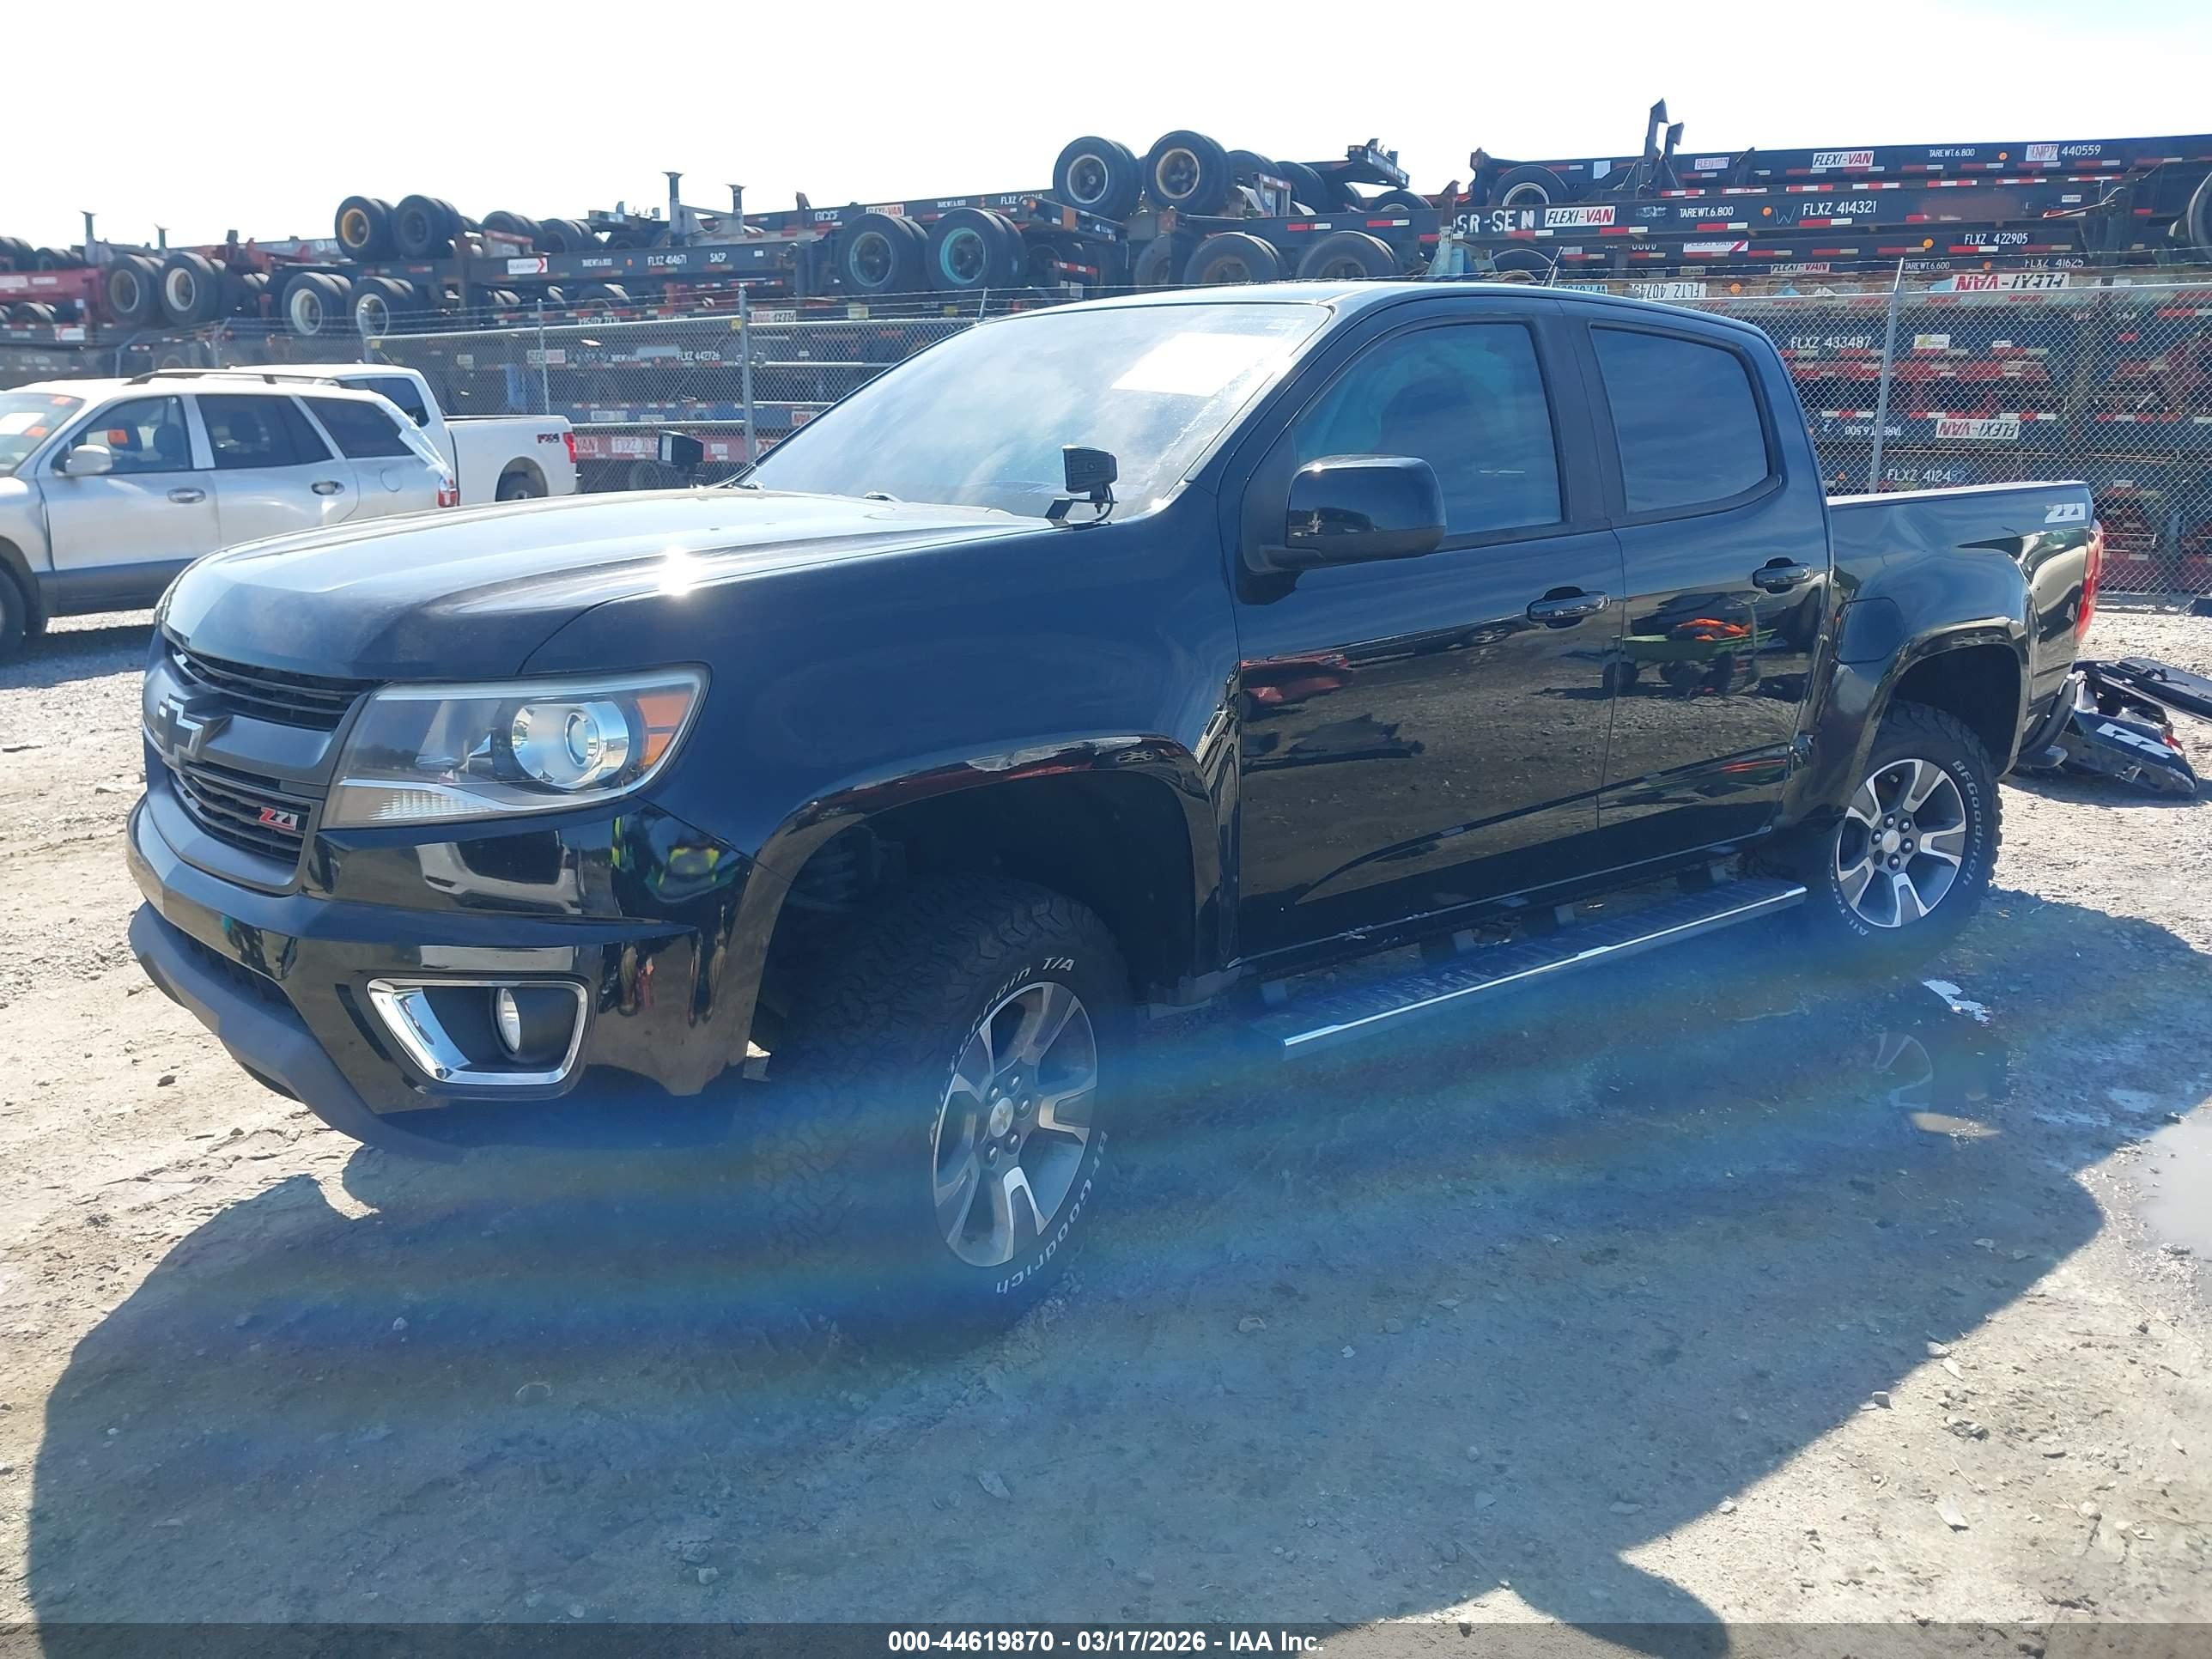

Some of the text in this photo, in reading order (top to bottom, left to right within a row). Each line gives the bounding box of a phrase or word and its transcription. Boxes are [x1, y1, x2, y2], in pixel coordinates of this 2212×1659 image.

[2061, 144, 2101, 156] 440559
[1814, 151, 1873, 167] FLEXI-VAN
[1802, 201, 1877, 215] FLXZ 414321
[1547, 208, 1614, 225] FLEXI-VAN
[1965, 233, 2029, 245] FLXZ 422905
[1954, 274, 2066, 291] FLEXI-VAN
[1791, 336, 1872, 349] FLXZ 433487
[1938, 422, 2019, 437] FLEXI-VAN
[1887, 469, 1918, 482] FLXZ
[259, 806, 299, 831] Z71
[1042, 957, 1075, 972] T/A
